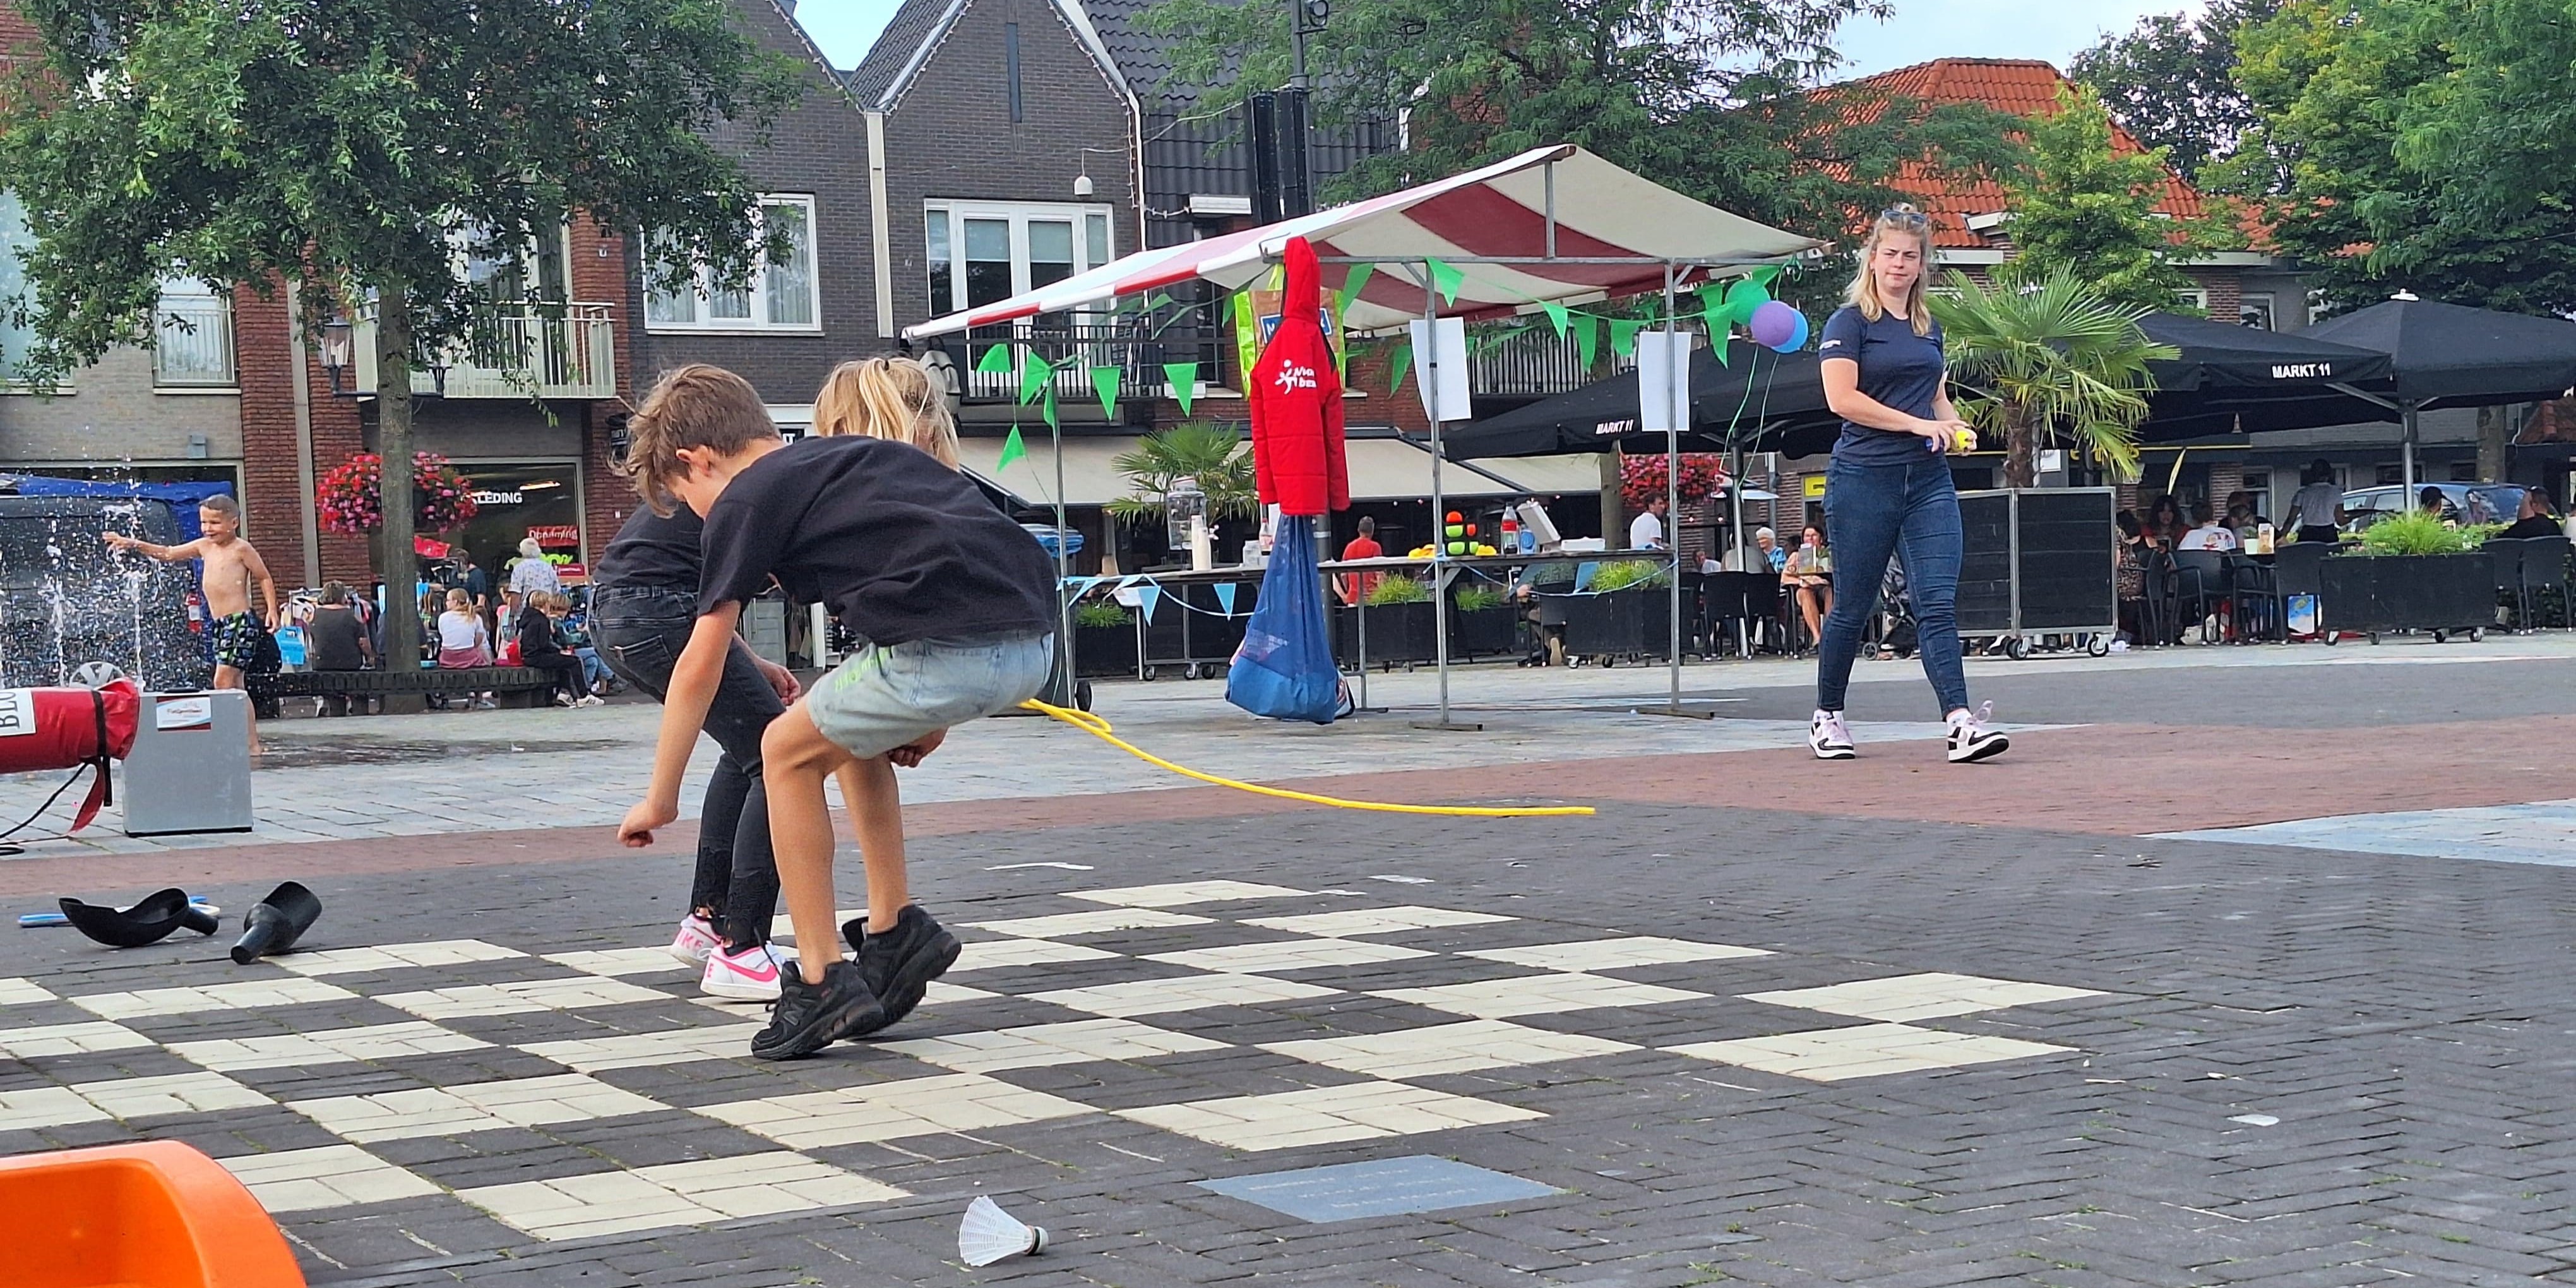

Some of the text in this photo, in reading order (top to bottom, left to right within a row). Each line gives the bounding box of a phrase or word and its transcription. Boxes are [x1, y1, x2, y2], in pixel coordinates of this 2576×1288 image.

[2272, 362, 2330, 378] MARKT 11
[1595, 420, 1626, 435] MARKT
[473, 491, 523, 504] LEDING
